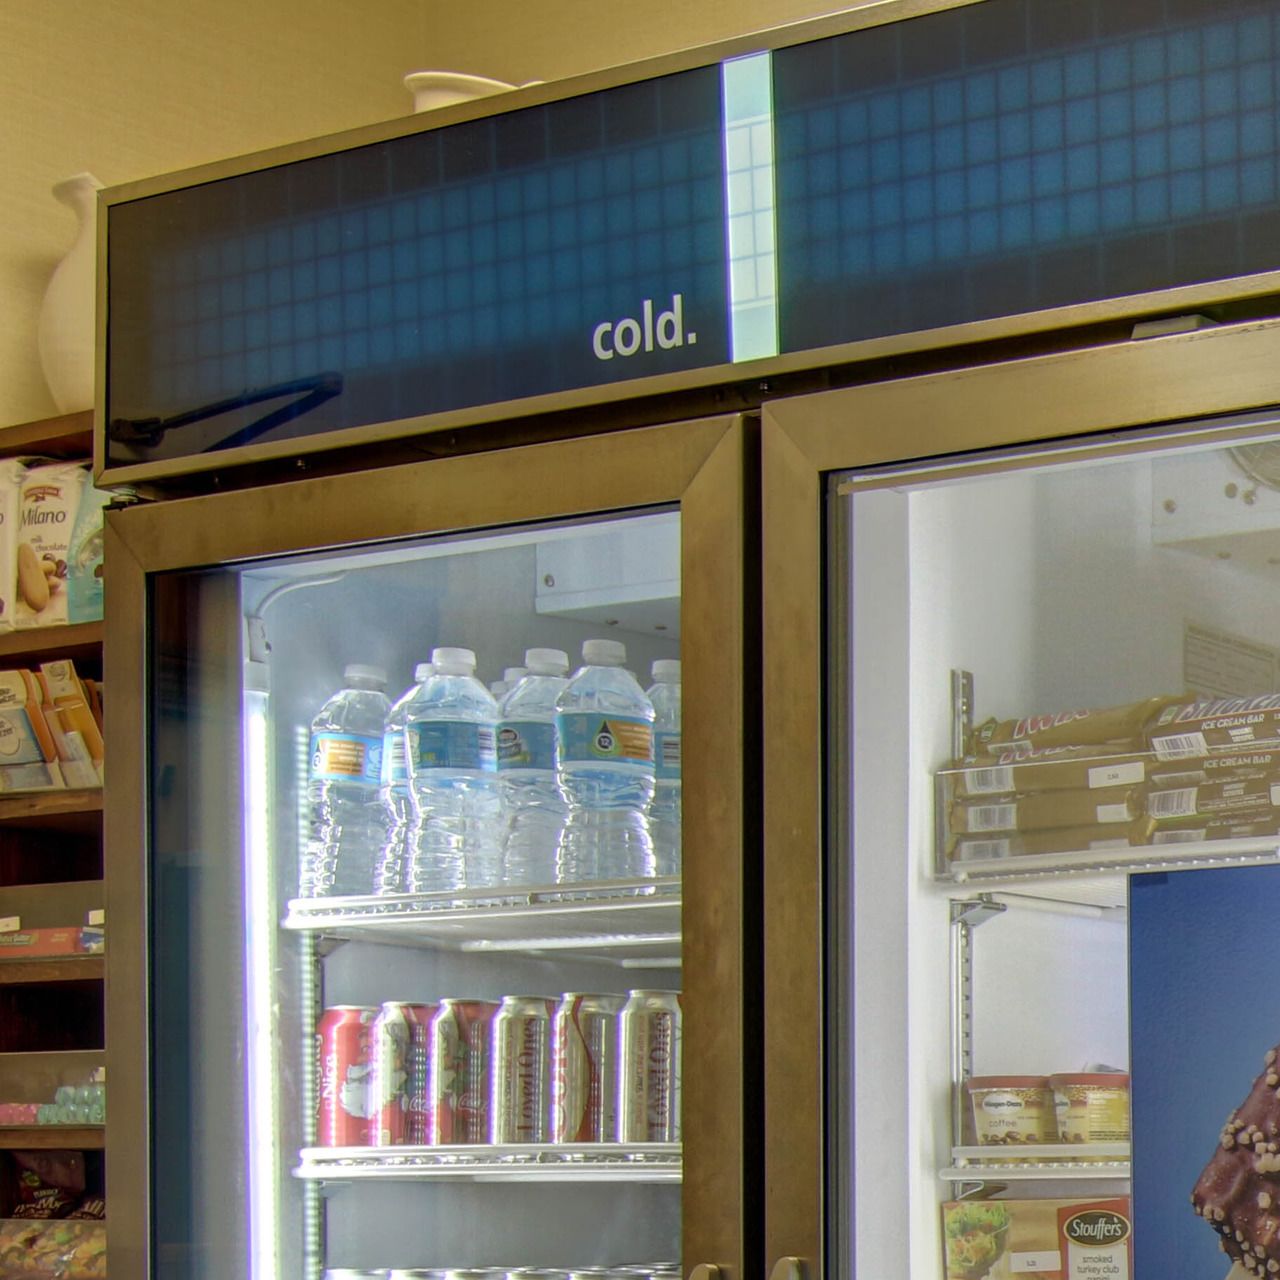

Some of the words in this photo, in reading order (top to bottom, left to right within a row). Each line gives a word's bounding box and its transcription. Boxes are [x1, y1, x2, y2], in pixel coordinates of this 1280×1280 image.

[593, 295, 697, 361] cold.
[20, 506, 67, 528] Milano
[1201, 720, 1216, 730] ICE
[1216, 717, 1247, 729] CREAM
[1247, 714, 1265, 724] BAR
[1203, 758, 1218, 769] ICE
[1219, 756, 1249, 768] CREAM
[1251, 754, 1273, 765] BAR
[988, 1119, 1018, 1128] coffee
[1071, 1217, 1122, 1241] Stouffer's
[1082, 1255, 1113, 1264] smoked
[1077, 1265, 1101, 1275] turkey
[1102, 1265, 1120, 1274] club
